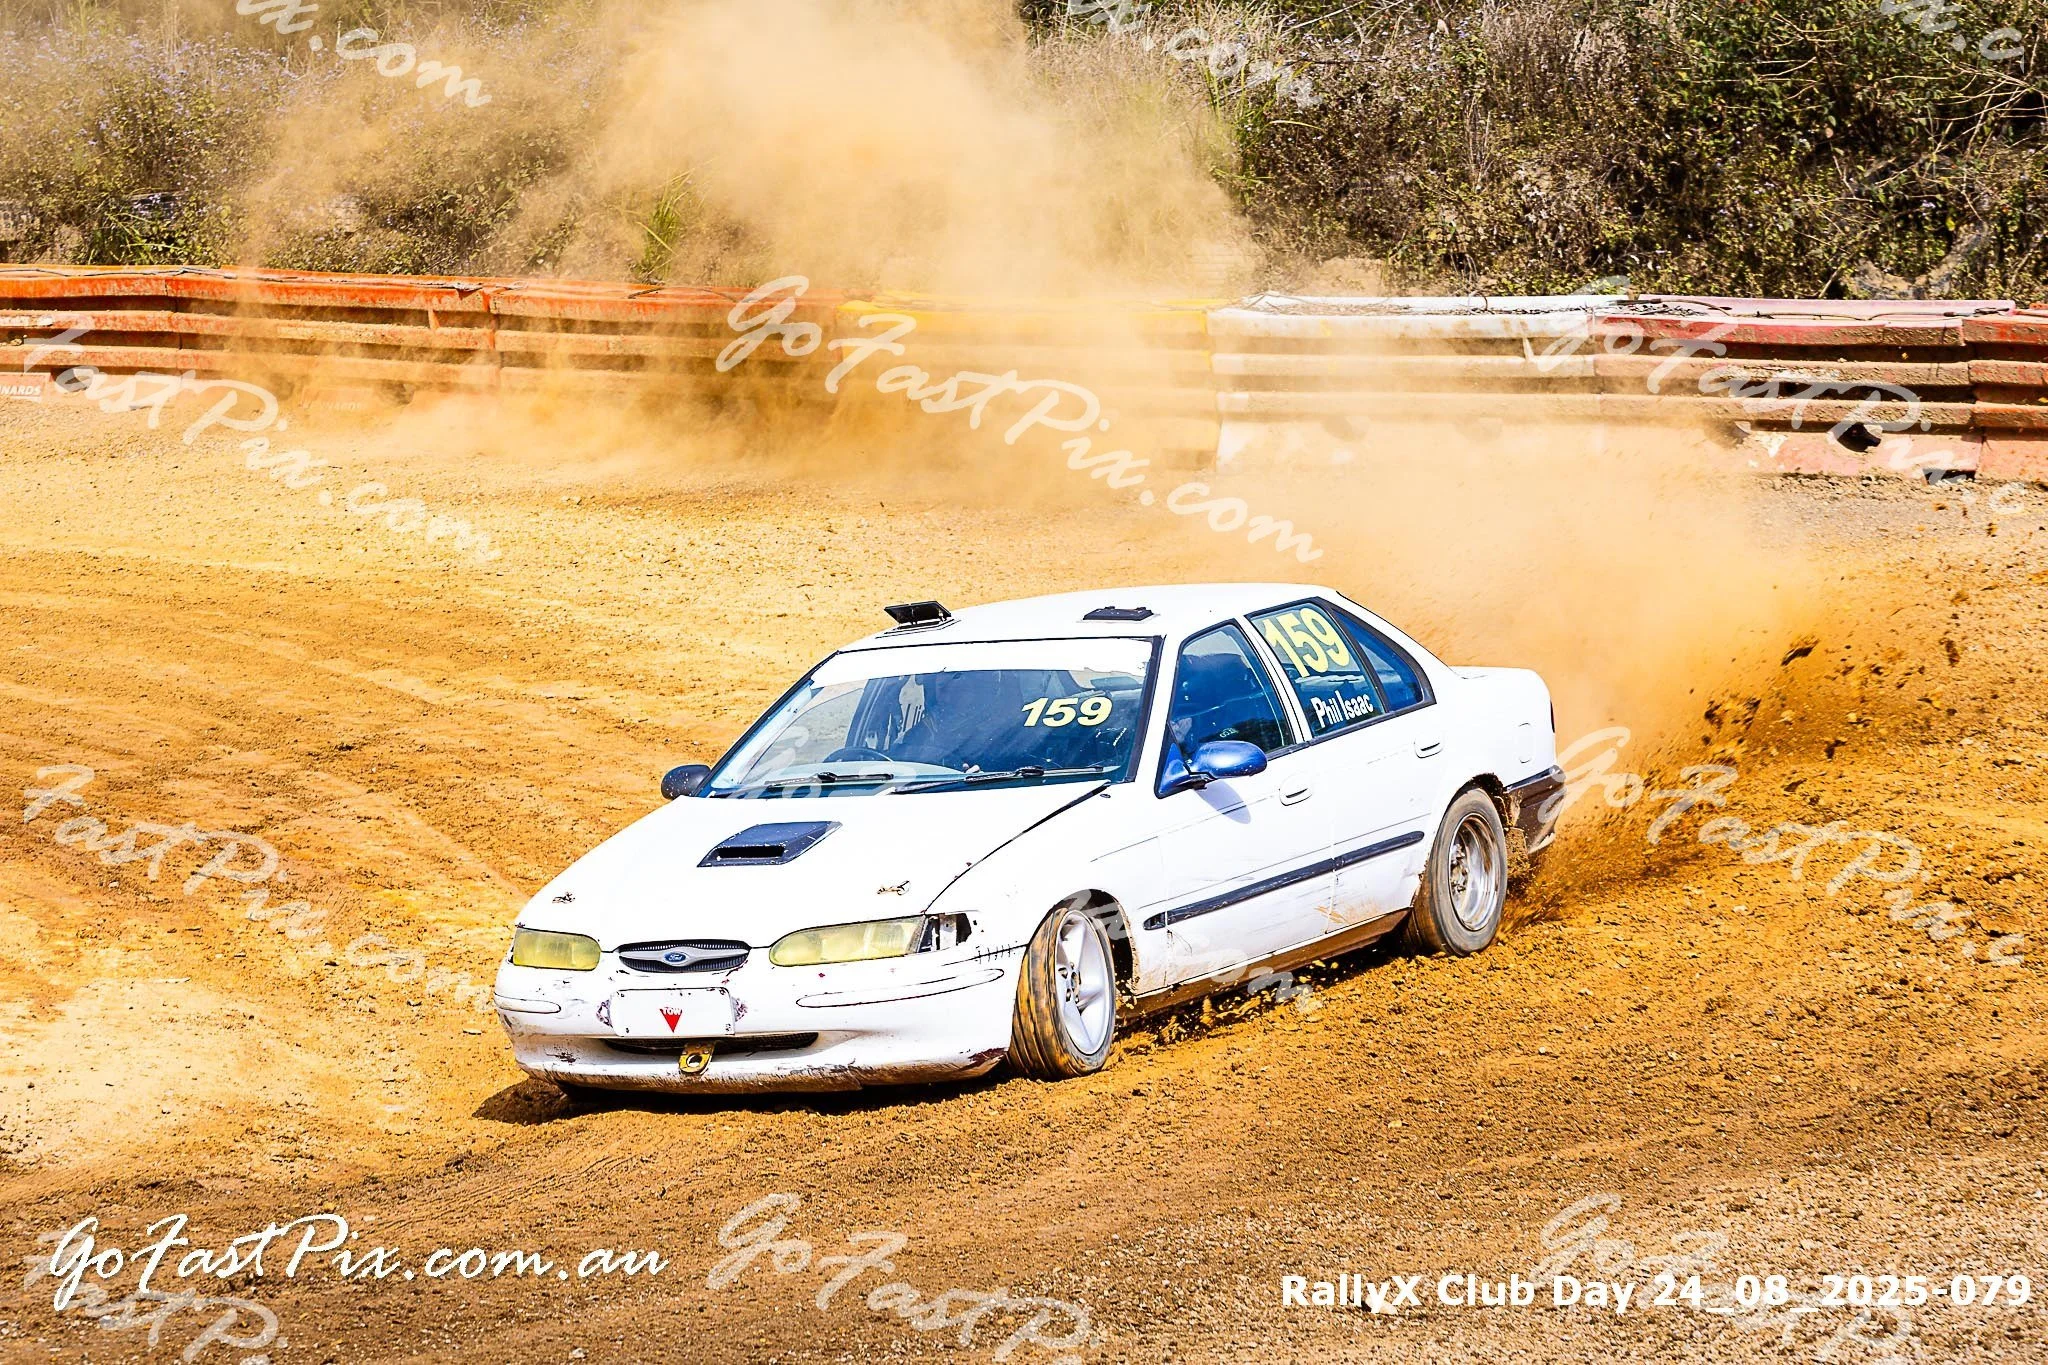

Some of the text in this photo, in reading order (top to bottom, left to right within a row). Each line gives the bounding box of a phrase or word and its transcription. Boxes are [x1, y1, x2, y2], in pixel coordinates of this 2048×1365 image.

[1263, 607, 1350, 678] 159
[1021, 696, 1113, 728] 159
[1310, 690, 1374, 729] Phil Isaac
[662, 1006, 683, 1016] TOW
